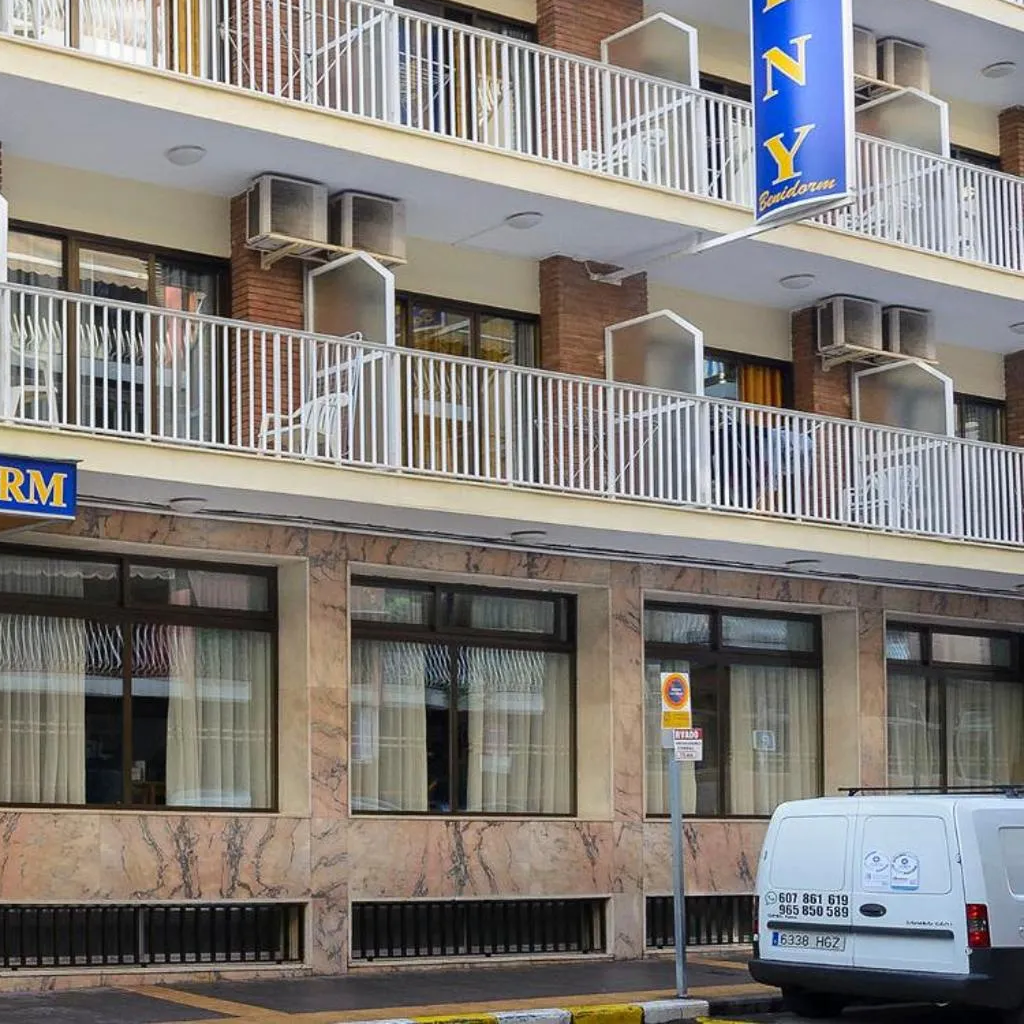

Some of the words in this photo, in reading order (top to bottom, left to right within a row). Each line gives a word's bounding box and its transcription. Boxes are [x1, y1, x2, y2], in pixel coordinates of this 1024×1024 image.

[758, 178, 836, 212] Benidorm
[778, 892, 798, 904] 607
[802, 893, 823, 905] 861
[828, 894, 849, 906] 619
[779, 904, 800, 916] 965
[802, 904, 824, 917] 850
[826, 906, 849, 918] 589
[780, 933, 809, 947] 6338
[816, 936, 841, 949] HGZ
